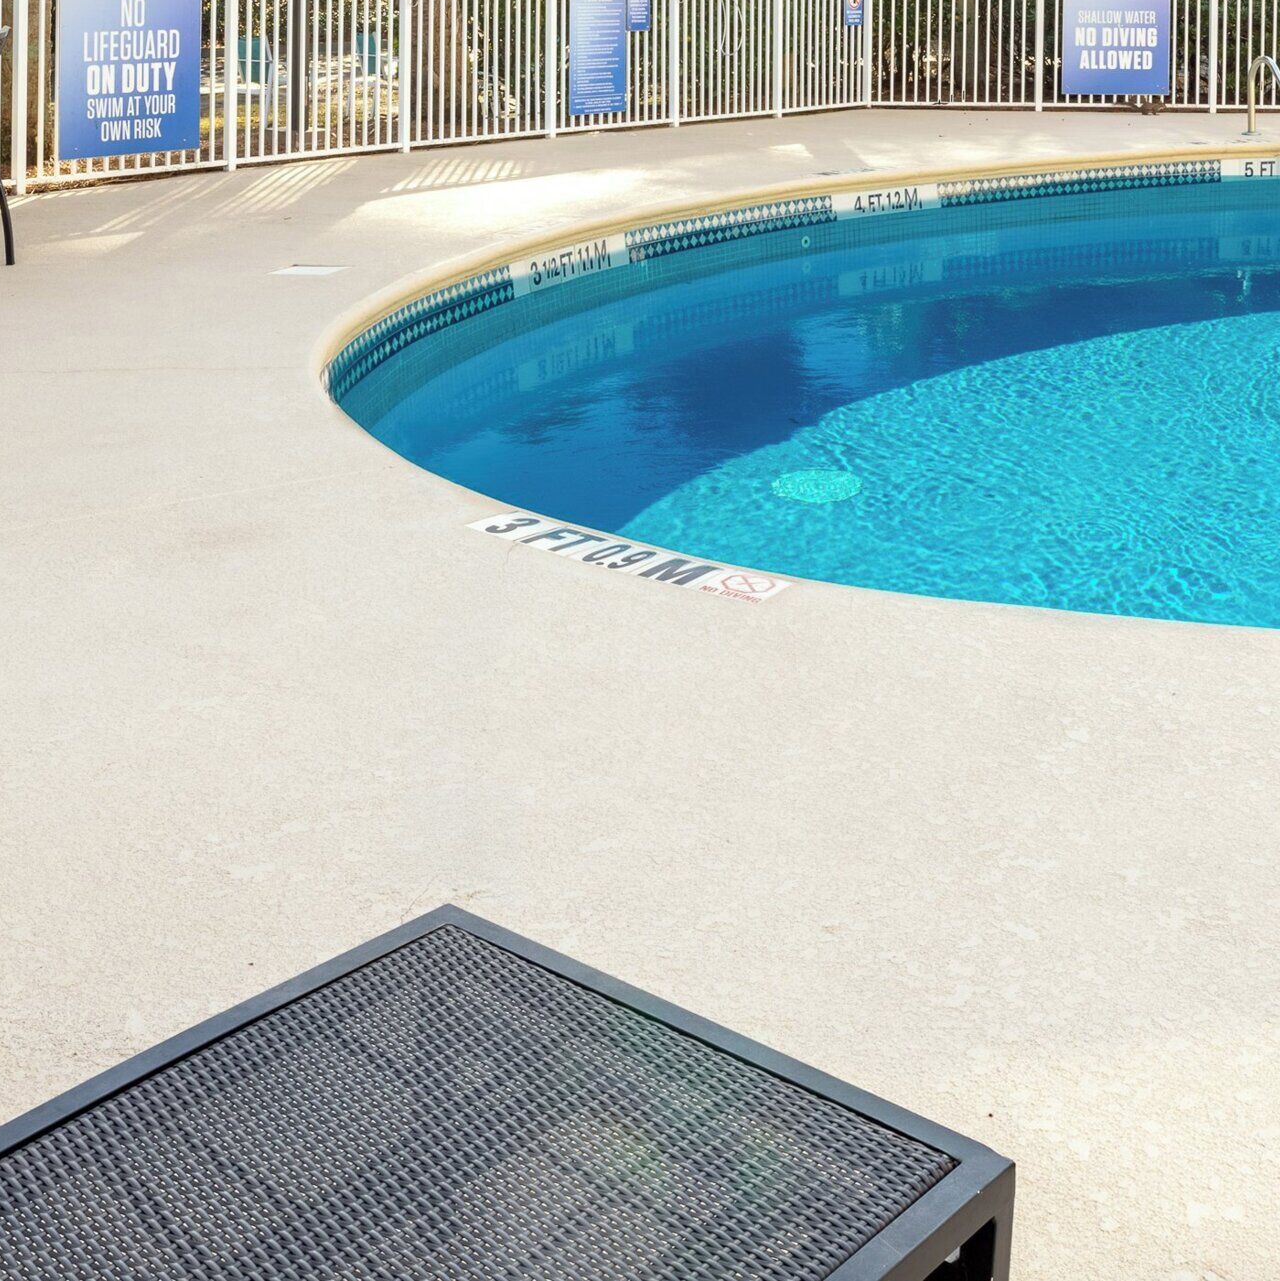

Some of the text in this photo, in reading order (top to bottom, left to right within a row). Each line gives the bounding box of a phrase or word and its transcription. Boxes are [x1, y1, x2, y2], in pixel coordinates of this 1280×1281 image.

[1078, 10, 1156, 25] SHALLOW WATER
[83, 29, 180, 62] LIFEGUARD
[1074, 27, 1158, 47] NO DIVING
[1079, 49, 1153, 70] ALLOWED
[86, 61, 177, 96] ON DUTY
[86, 93, 176, 119] SWIM AT YOUR
[100, 118, 162, 142] OWN RISK
[1244, 161, 1254, 177] 5
[1260, 160, 1275, 177] FT
[854, 195, 864, 211] 4
[868, 193, 884, 211] FT
[904, 187, 922, 210] M
[530, 261, 542, 285] 3
[560, 251, 575, 277] FT
[594, 239, 611, 269] M
[485, 517, 723, 586] 3 FT 0.9 M
[699, 585, 762, 603] NO DIVING
